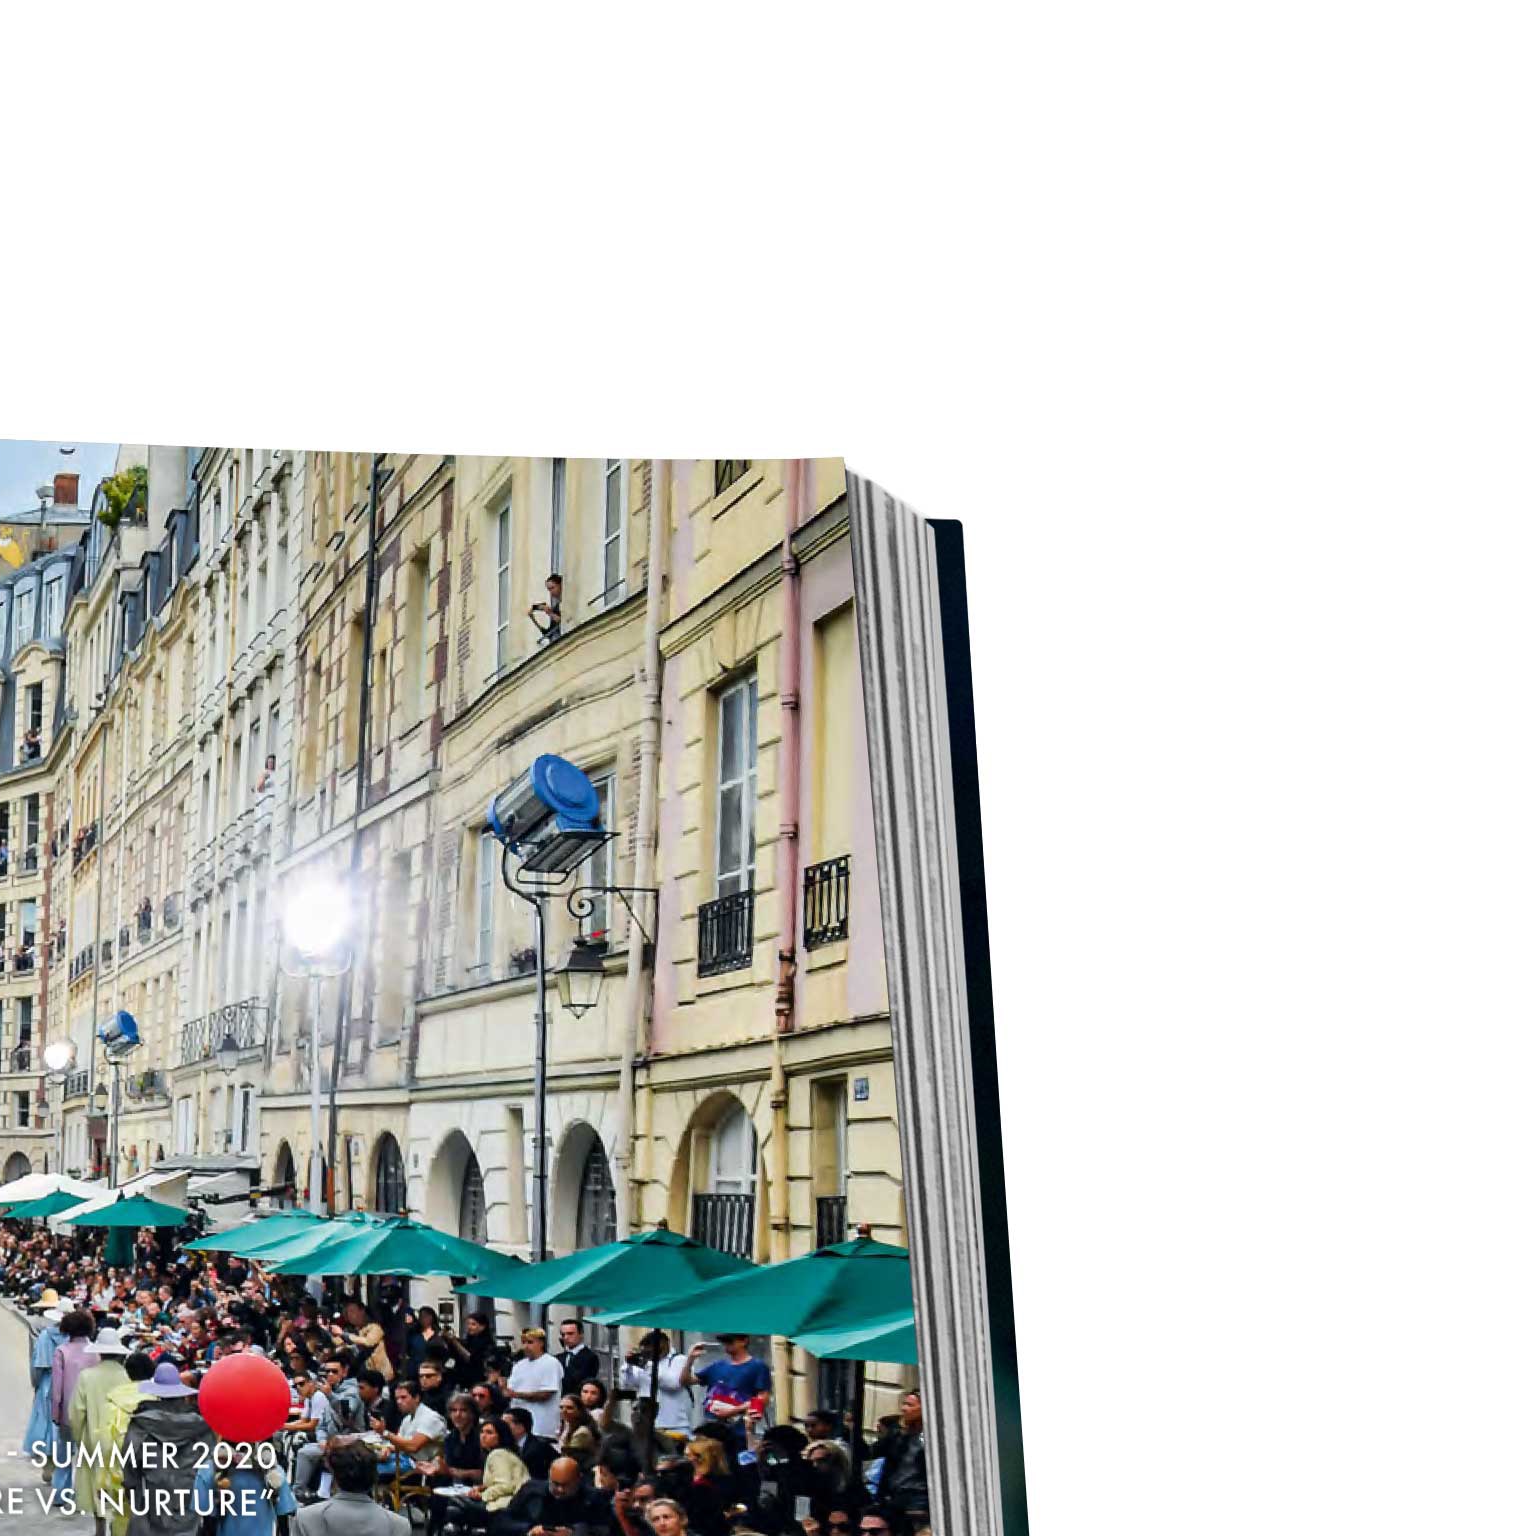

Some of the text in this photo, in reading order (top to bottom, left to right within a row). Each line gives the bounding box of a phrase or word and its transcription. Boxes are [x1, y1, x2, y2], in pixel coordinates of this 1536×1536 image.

[31, 1440, 179, 1468] SUMMER
[192, 1442, 276, 1470] 2020
[35, 1487, 86, 1516] VS.
[99, 1488, 275, 1517] NURTURE”
